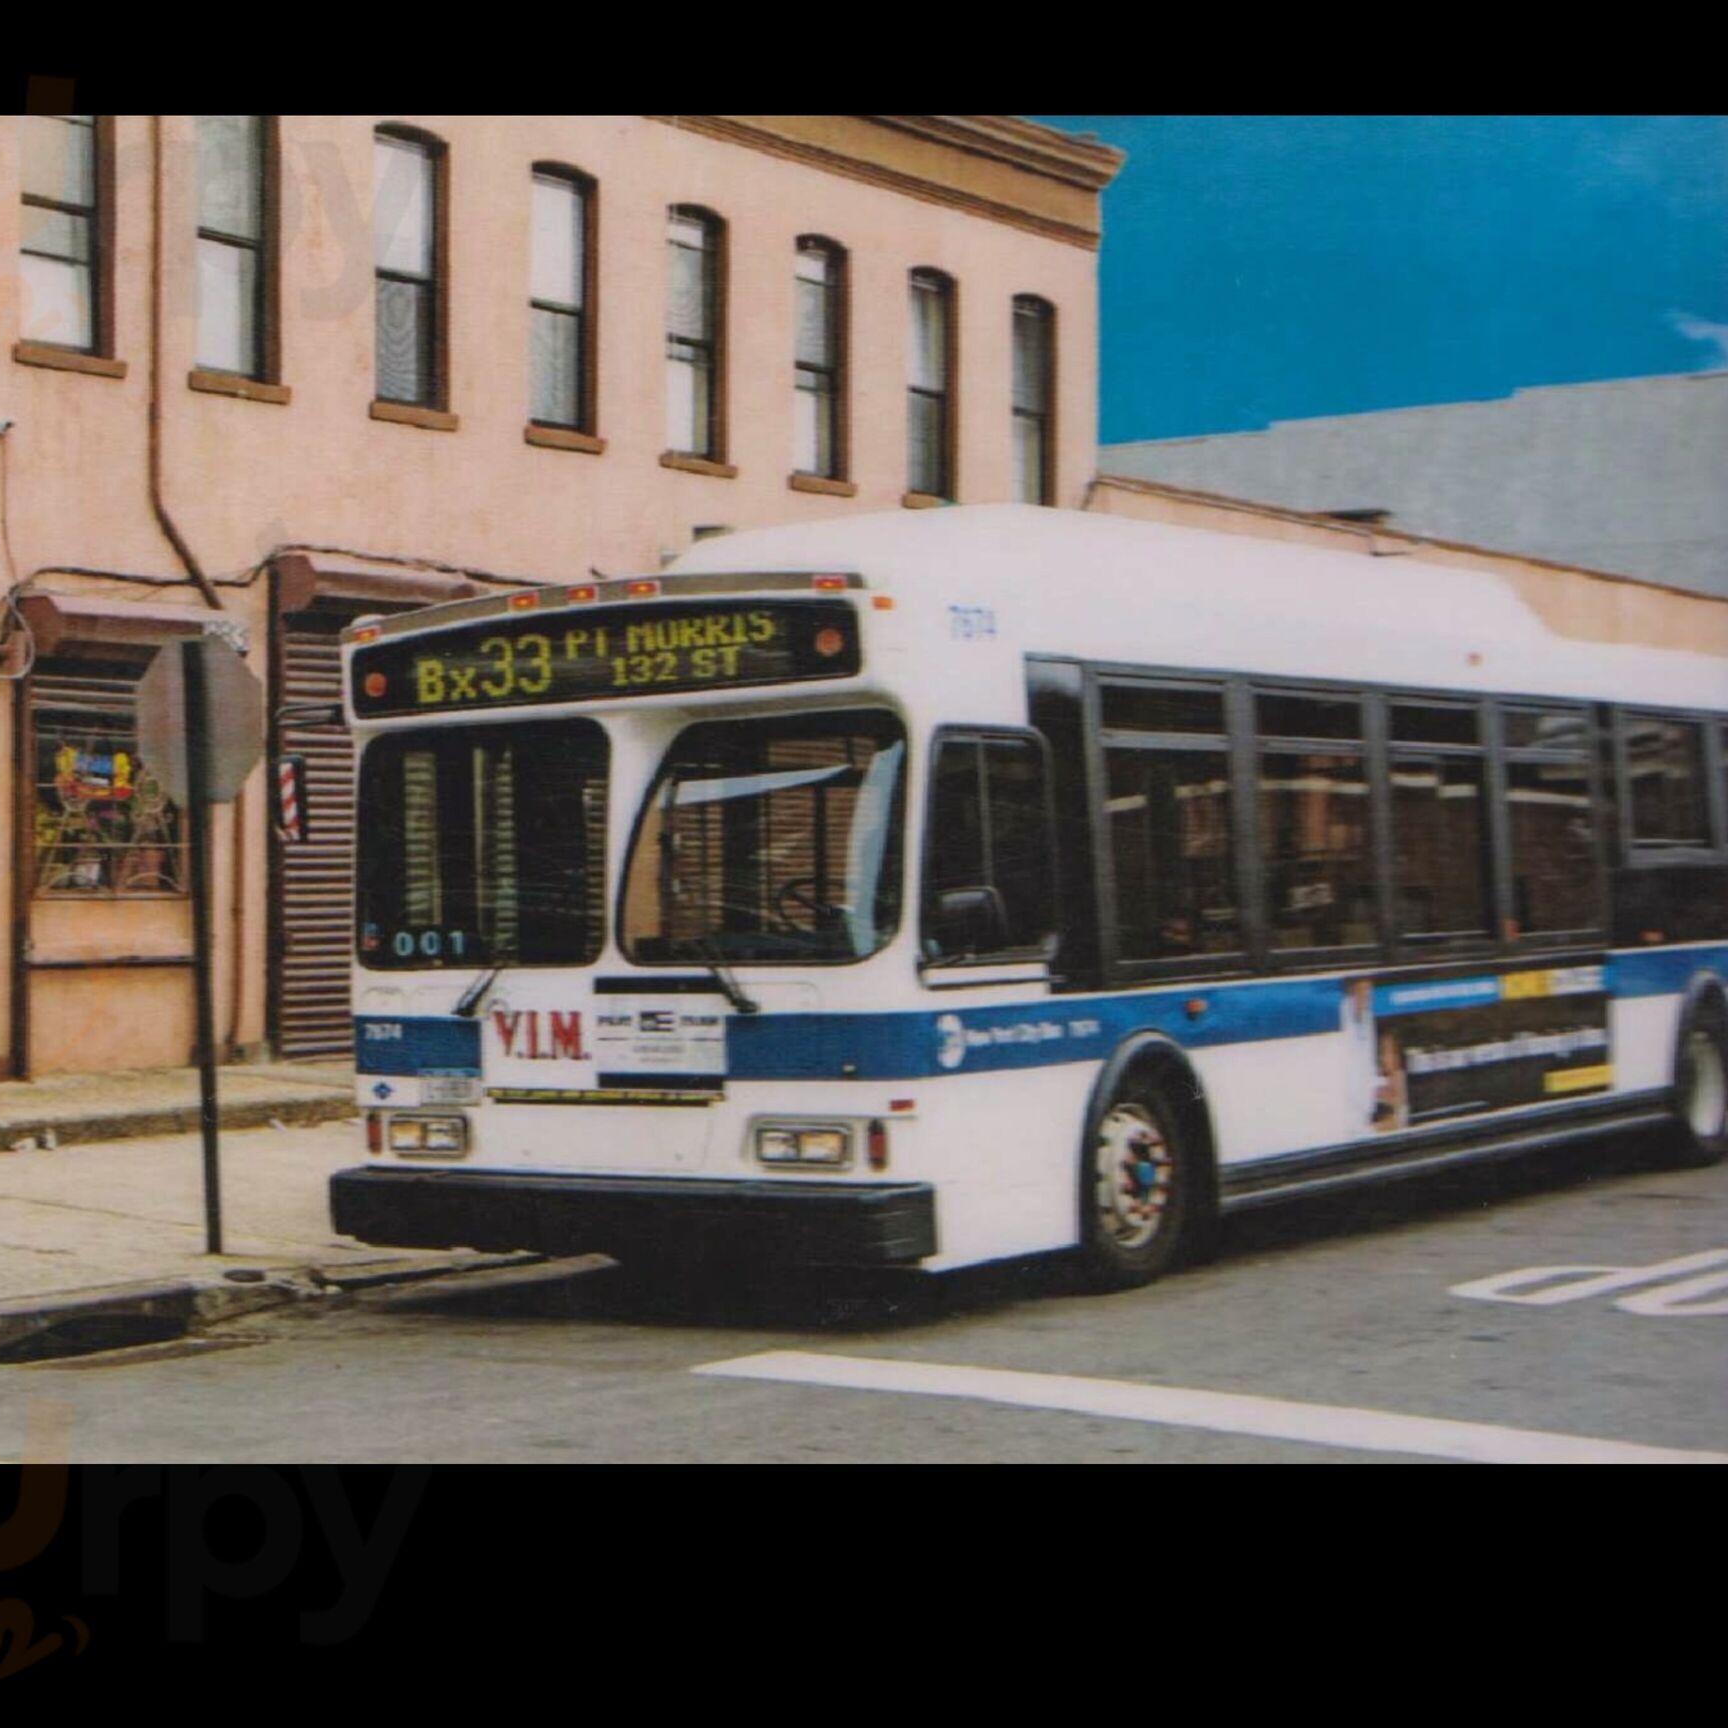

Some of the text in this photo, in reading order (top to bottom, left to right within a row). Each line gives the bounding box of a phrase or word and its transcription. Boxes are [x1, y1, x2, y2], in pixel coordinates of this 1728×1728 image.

[416, 633, 554, 705] Bx33
[626, 611, 775, 653] MORRIS
[611, 646, 743, 688] 132 ST
